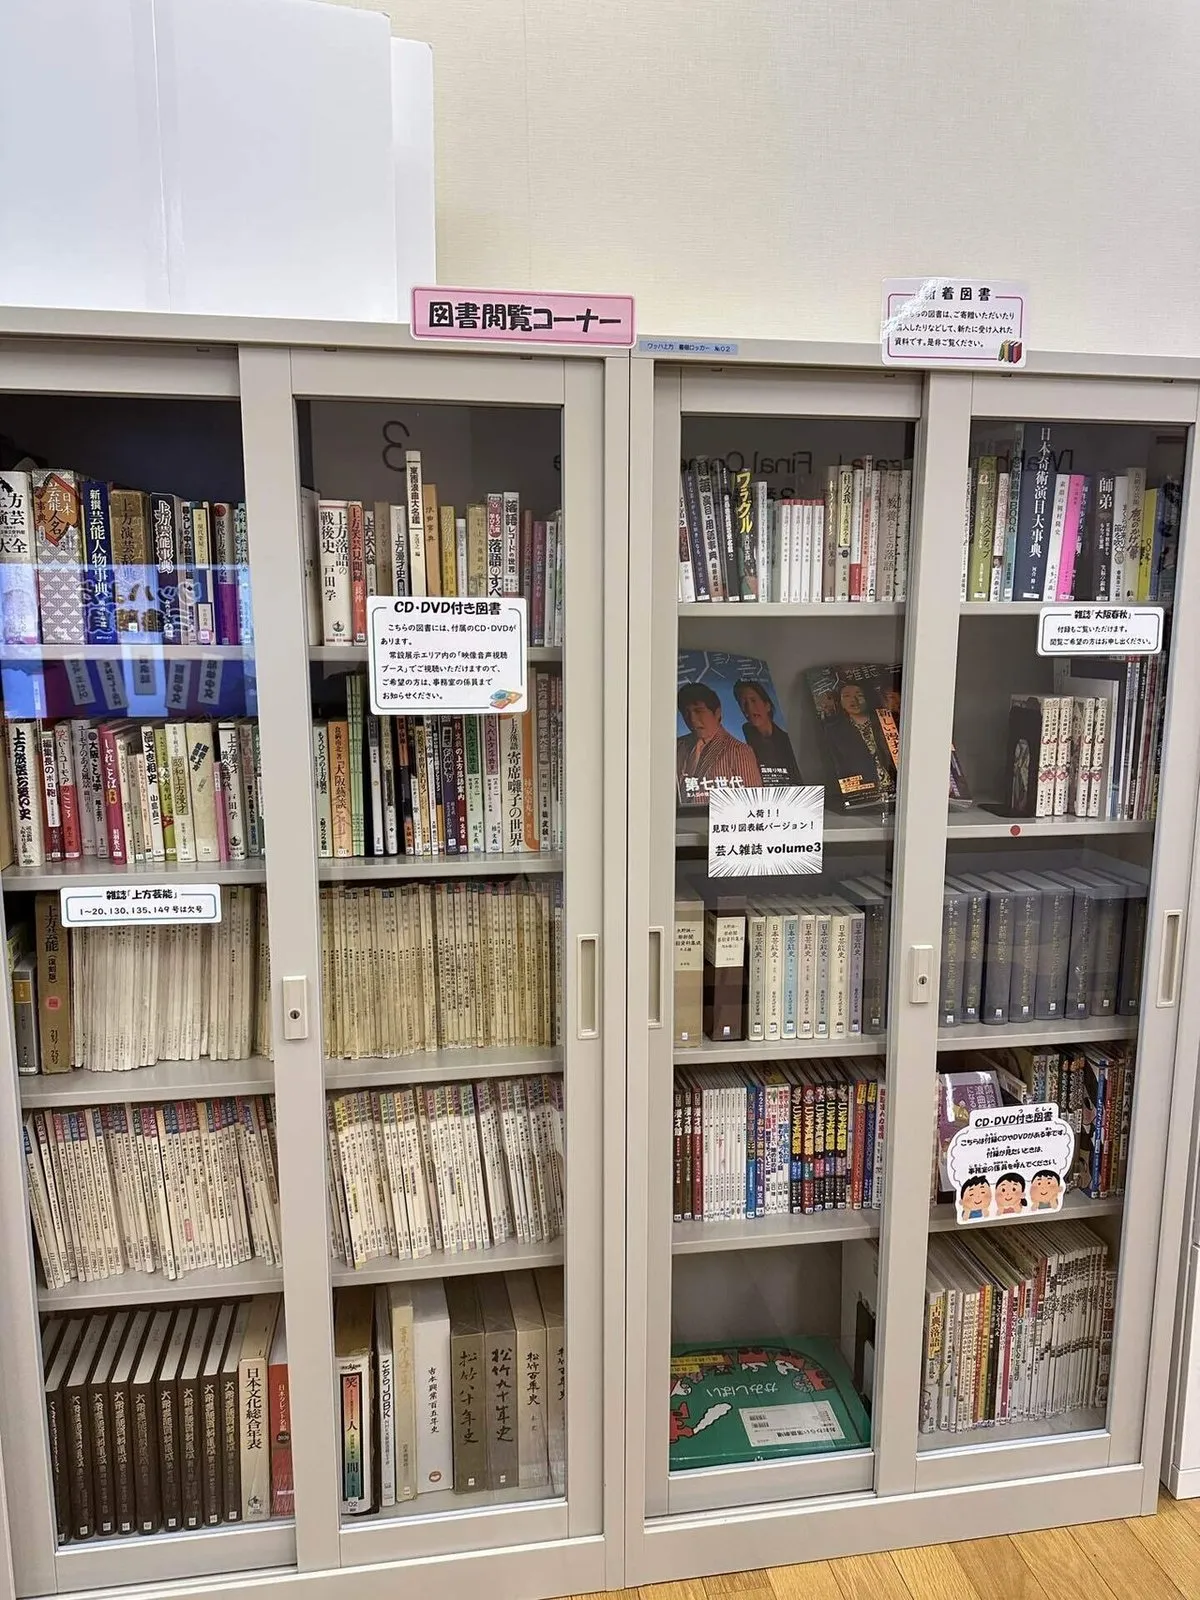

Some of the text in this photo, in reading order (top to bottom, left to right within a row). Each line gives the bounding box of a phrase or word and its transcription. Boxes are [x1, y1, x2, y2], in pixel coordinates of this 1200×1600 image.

[428, 300, 621, 333] 図書閲覧コーナー
[910, 310, 1015, 320] らの図書は、ご寄贈いただいたり
[895, 338, 984, 347] 資料です。是非ご覧ください。
[47, 482, 63, 512] 芸能
[1100, 477, 1113, 509] 師弟
[63, 492, 75, 516] 日本
[155, 500, 174, 575] 上方芸能事典
[320, 511, 336, 554] 戦後史
[336, 511, 349, 576] 上方落語の
[394, 601, 501, 616] CD・DVD付き図書
[388, 624, 516, 633] こちらの図書には、付属のCD・DVDが
[1057, 625, 1128, 633] 付録もご覧いただけます。
[380, 637, 412, 646] あります。
[388, 651, 508, 660] 常設展示エリア内の「映像音声視聴
[382, 665, 501, 673] ブース」でご視聴いただけますので、
[382, 679, 493, 687] ご希望の方は、事務室の係員まで
[382, 692, 443, 700] お知らせください。
[90, 741, 103, 792] 大阪ことば学
[104, 739, 116, 788] しゃれことば
[684, 776, 744, 792] 第七世代
[712, 821, 814, 833] 見取り図表紙バージョン！
[715, 842, 822, 857] 芸人雑誌 volume3
[45, 905, 59, 953] 上方芸能
[975, 1111, 1053, 1128] CD・DVD付き図書
[525, 1351, 541, 1406] 松竹百年史
[458, 1350, 480, 1446] 松竹八十年史
[491, 1347, 514, 1444] 松竹九十年史
[245, 1368, 263, 1450] 日本文化総合年表
